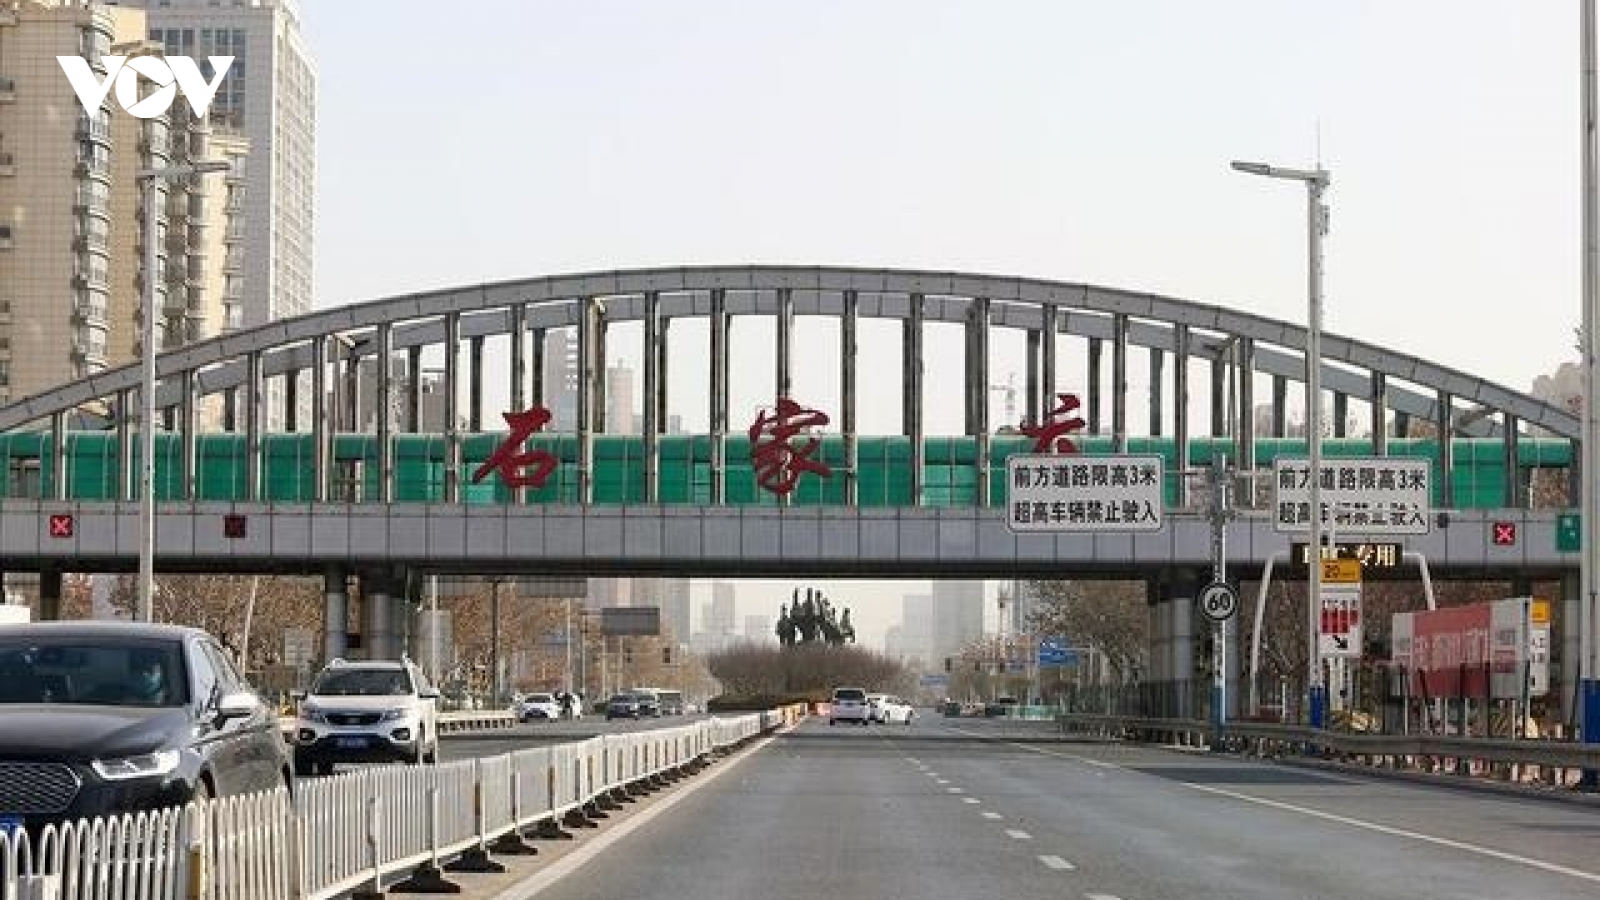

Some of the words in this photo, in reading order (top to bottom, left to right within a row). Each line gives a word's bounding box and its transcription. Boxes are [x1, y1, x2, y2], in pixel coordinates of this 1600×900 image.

[1014, 465, 1156, 488] 前方道路限高3米
[1279, 468, 1426, 491] 前方道路限高3米
[1014, 500, 1157, 524] 超高车辆禁止驶入
[1207, 593, 1231, 611] 60
